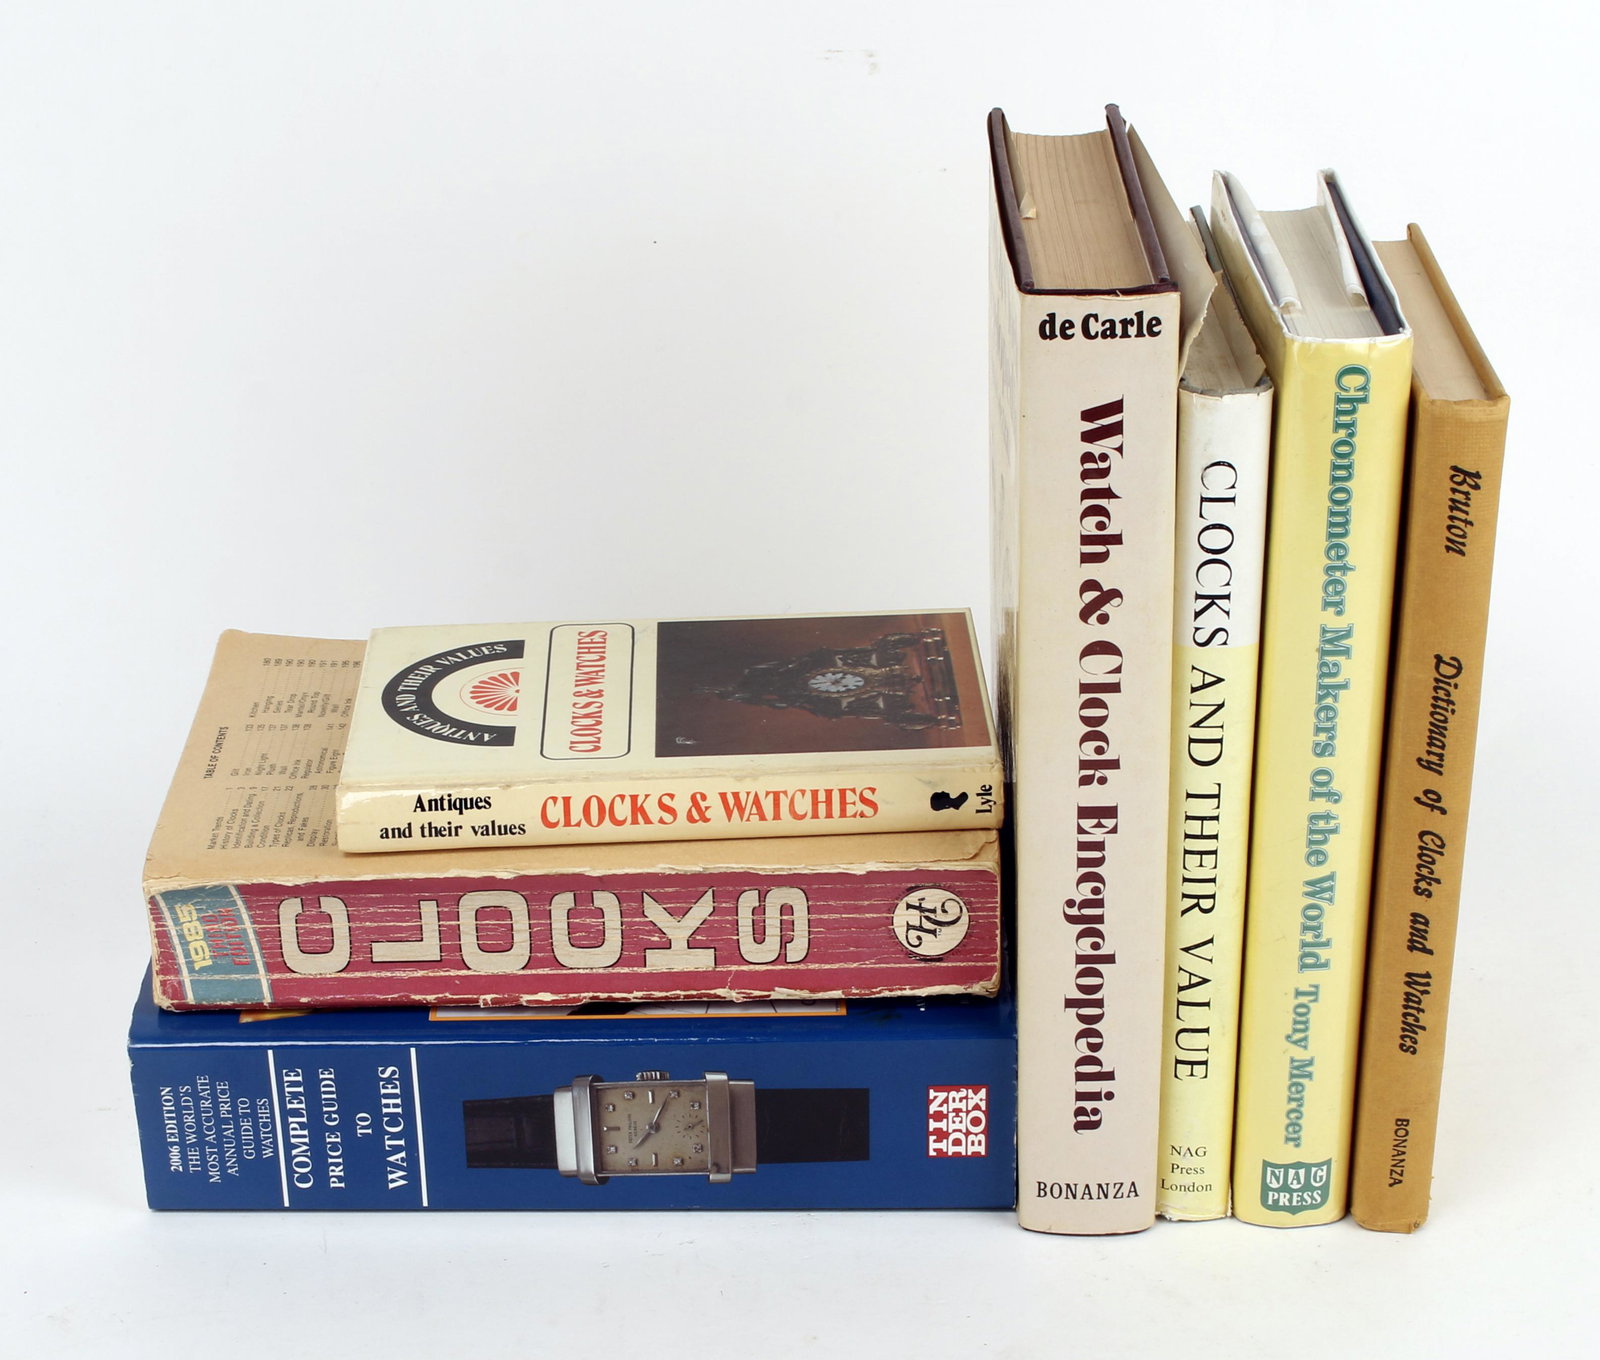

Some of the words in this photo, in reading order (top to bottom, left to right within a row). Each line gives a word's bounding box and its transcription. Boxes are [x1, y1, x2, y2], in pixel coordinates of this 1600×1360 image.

[1038, 312, 1075, 341] de
[1080, 310, 1163, 341] Carle
[1078, 393, 1125, 568] Watch
[1321, 363, 1371, 616] Chronometer
[1444, 464, 1482, 557] Bruton
[1191, 460, 1238, 648] CLOCKS
[1078, 578, 1125, 626] &
[397, 664, 442, 692] THEIR
[435, 643, 507, 667] VALUES
[574, 630, 609, 688] WATCHES
[395, 691, 420, 712] AND
[572, 688, 604, 699] &
[1078, 639, 1125, 788] Clock
[1186, 665, 1227, 768] AND
[1311, 623, 1354, 758] Makers
[1416, 653, 1463, 776] Dictionary
[203, 763, 217, 779] TABLE
[212, 726, 228, 753] CONTENTS
[406, 713, 498, 743] ANTIQUES
[568, 700, 605, 753] CLOCKS
[413, 793, 492, 815] Antiques
[540, 792, 678, 829] CLOCKS
[686, 791, 712, 824] &
[718, 786, 879, 823] WATCHES
[975, 784, 993, 814] Lyle
[1309, 766, 1342, 804] of
[1413, 788, 1447, 815] of
[379, 822, 413, 839] and
[420, 820, 463, 838] their
[470, 819, 526, 837] values
[1179, 782, 1222, 917] THEIR
[1304, 809, 1340, 867] the
[1412, 829, 1446, 899] Clocks
[174, 904, 213, 970] 1985
[279, 885, 810, 975] CLOCKS
[1298, 871, 1337, 973] World
[1407, 911, 1434, 955] and
[1062, 802, 1119, 1136] Encyclopedia
[1173, 934, 1217, 1082] VALUE
[1285, 984, 1320, 1050] Tony
[1399, 969, 1432, 1056] Watches
[160, 1086, 180, 1142] EDITION
[179, 1085, 198, 1144] WORLD'S
[196, 1075, 216, 1143] ACCURATE
[216, 1081, 232, 1118] PRICE
[238, 1098, 251, 1115] TO
[318, 1068, 339, 1126] GUIDE
[356, 1113, 372, 1137] TO
[929, 1088, 948, 1156] TIN
[948, 1088, 967, 1156] DER
[966, 1088, 986, 1156] BOX
[1284, 1056, 1315, 1148] Mercer
[223, 1120, 239, 1176] ANNUAL
[240, 1118, 256, 1159] GUIDE
[257, 1098, 274, 1159] WATCHES
[282, 1068, 314, 1189] COMPLETE
[378, 1065, 408, 1189] WATCHES
[1169, 1144, 1208, 1158] NAG
[1388, 1117, 1410, 1188] BONANZA
[168, 1145, 183, 1172] 2006
[188, 1147, 201, 1173] THE
[205, 1145, 221, 1183] MOST
[325, 1132, 345, 1188] PRICE
[1160, 1178, 1213, 1193] London
[1170, 1163, 1205, 1175] Press
[1036, 1180, 1140, 1200] BONANZA
[1267, 1190, 1322, 1206] PRESS
